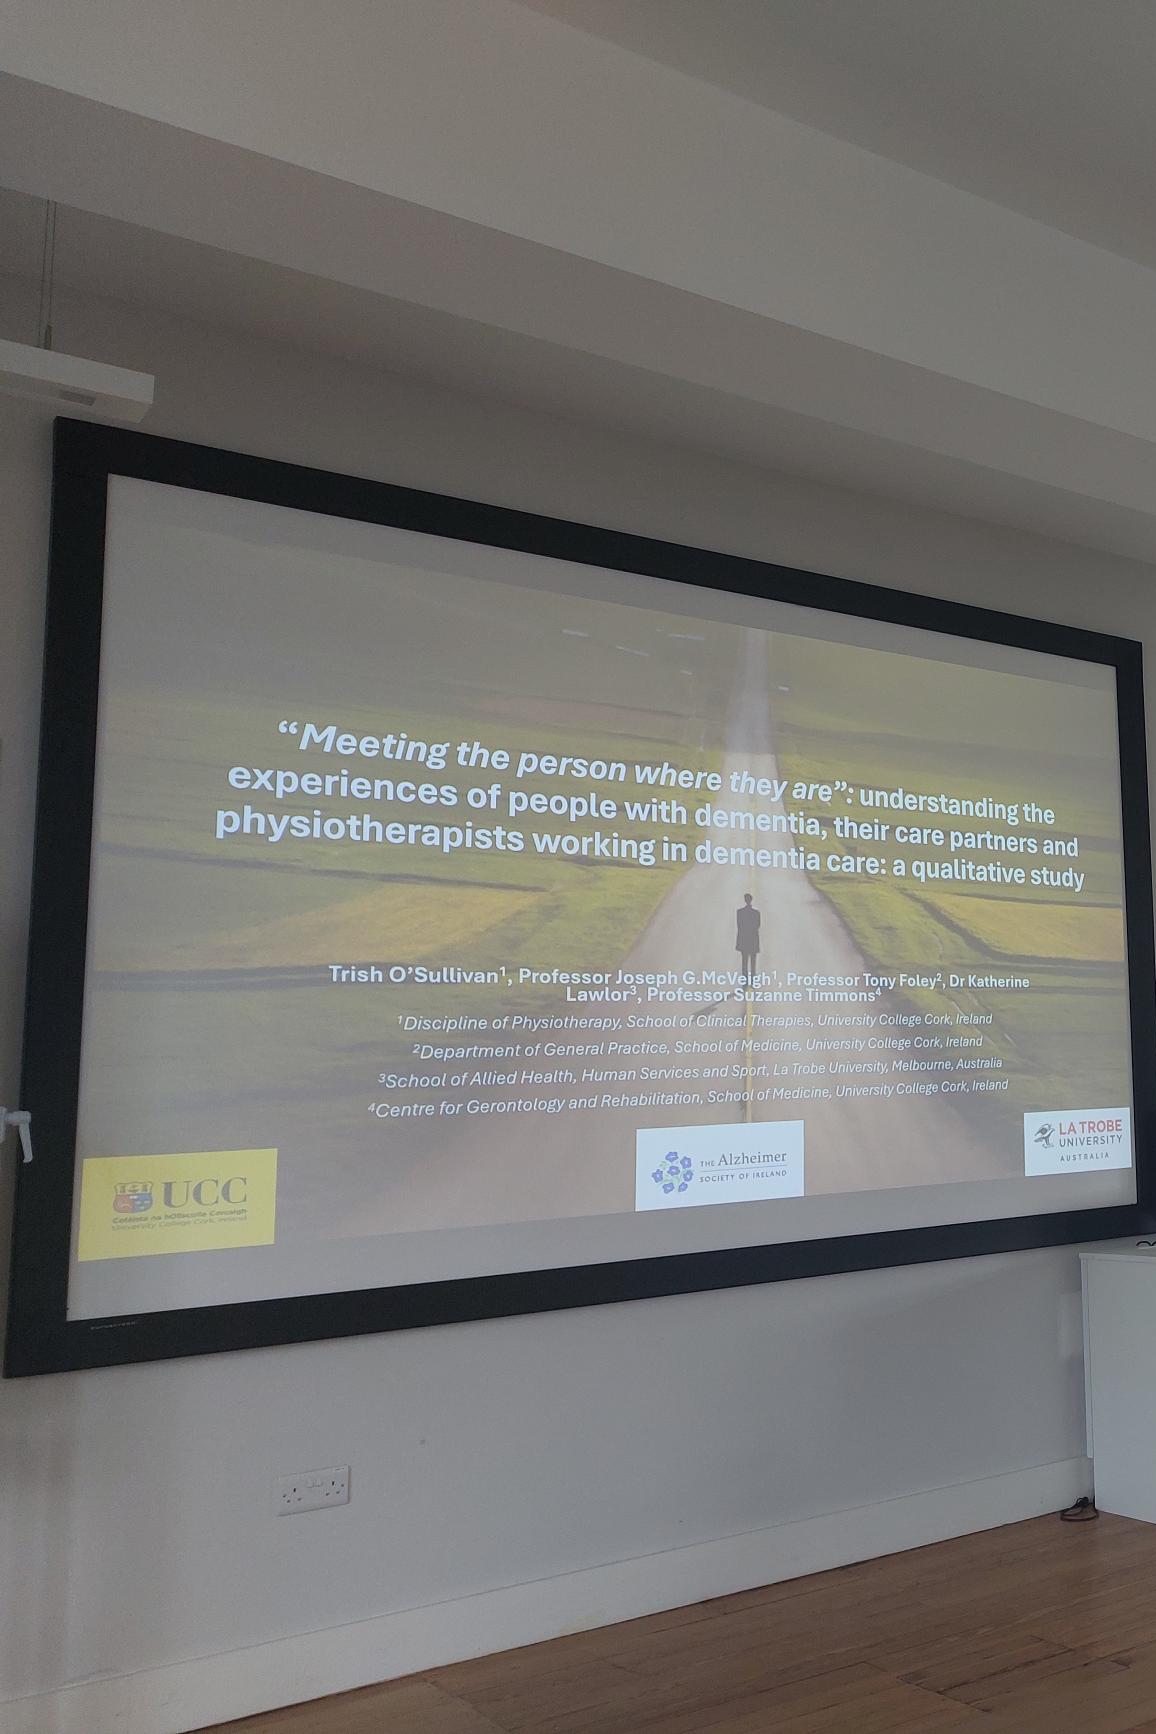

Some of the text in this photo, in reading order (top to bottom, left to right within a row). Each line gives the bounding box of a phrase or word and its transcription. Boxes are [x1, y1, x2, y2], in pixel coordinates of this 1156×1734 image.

[278, 720, 449, 769] “Meeting
[456, 741, 510, 770] the
[517, 751, 627, 781] person
[635, 762, 722, 791] where
[730, 771, 788, 802] they
[860, 786, 1019, 826] understanding
[1023, 802, 1056, 825] the
[228, 765, 1079, 858] experiences of people with dementia, their care partners and
[215, 805, 1086, 893] physiotherapists working in dementia care: a qualitative study
[328, 965, 383, 984] Trish
[519, 968, 611, 985] Professor
[616, 970, 678, 987] Joseph
[787, 972, 860, 987] Professor
[863, 973, 896, 990] Tony
[950, 974, 965, 988] Dr
[968, 974, 1030, 989] Katherine
[648, 988, 731, 1002] Professor
[734, 987, 803, 1002] Suzanne
[491, 1016, 508, 1029] of
[512, 1015, 623, 1032] Physiotherapy,
[626, 1015, 676, 1028] School
[679, 1015, 693, 1028] of
[696, 1014, 747, 1027] Clinical
[750, 1014, 814, 1029] Therapies,
[818, 1014, 876, 1028] University
[879, 1013, 922, 1027] College
[924, 1014, 953, 1026] Cork,
[956, 1013, 993, 1025] Ireland
[524, 1043, 541, 1057] of
[544, 1042, 604, 1056] General
[607, 1040, 670, 1055] Practice,
[674, 1040, 722, 1053] School
[725, 1040, 739, 1052] of
[741, 1039, 802, 1052] Medicine,
[806, 1038, 865, 1051] University
[868, 1037, 911, 1050] College
[914, 1036, 943, 1049] Cork,
[946, 1035, 983, 1047] Ireland
[450, 1072, 469, 1086] of
[470, 1071, 516, 1086] Allied
[520, 1070, 577, 1084] Health,
[581, 1068, 636, 1082] Human
[640, 1066, 699, 1080] Services
[703, 1065, 729, 1078] and
[731, 1064, 770, 1078] Sport,
[773, 1063, 788, 1075] La
[792, 1062, 826, 1075] Trobe
[829, 1061, 889, 1075] University,
[892, 1059, 954, 1072] Melbourne,
[956, 1057, 1003, 1070] Australia
[439, 1102, 461, 1116] for
[466, 1099, 566, 1115] Gerontology
[569, 1096, 598, 1111] and
[601, 1093, 703, 1107] Rehabilitation,
[707, 1090, 754, 1104] School
[757, 1089, 771, 1101] of
[772, 1086, 832, 1100] Medicine,
[835, 1084, 894, 1099] University
[897, 1082, 939, 1096] College
[941, 1081, 970, 1094] Cork,
[972, 1079, 1009, 1091] Ireland
[1059, 1119, 1122, 1135] LA TROBE
[1060, 1135, 1122, 1147] UNIVERSITY
[718, 1152, 787, 1166] Alzheimer
[1060, 1152, 1109, 1162] AUSTRALIA
[700, 1170, 787, 1182] SOCIETY OF IRELAND
[163, 1176, 248, 1208] UCC
